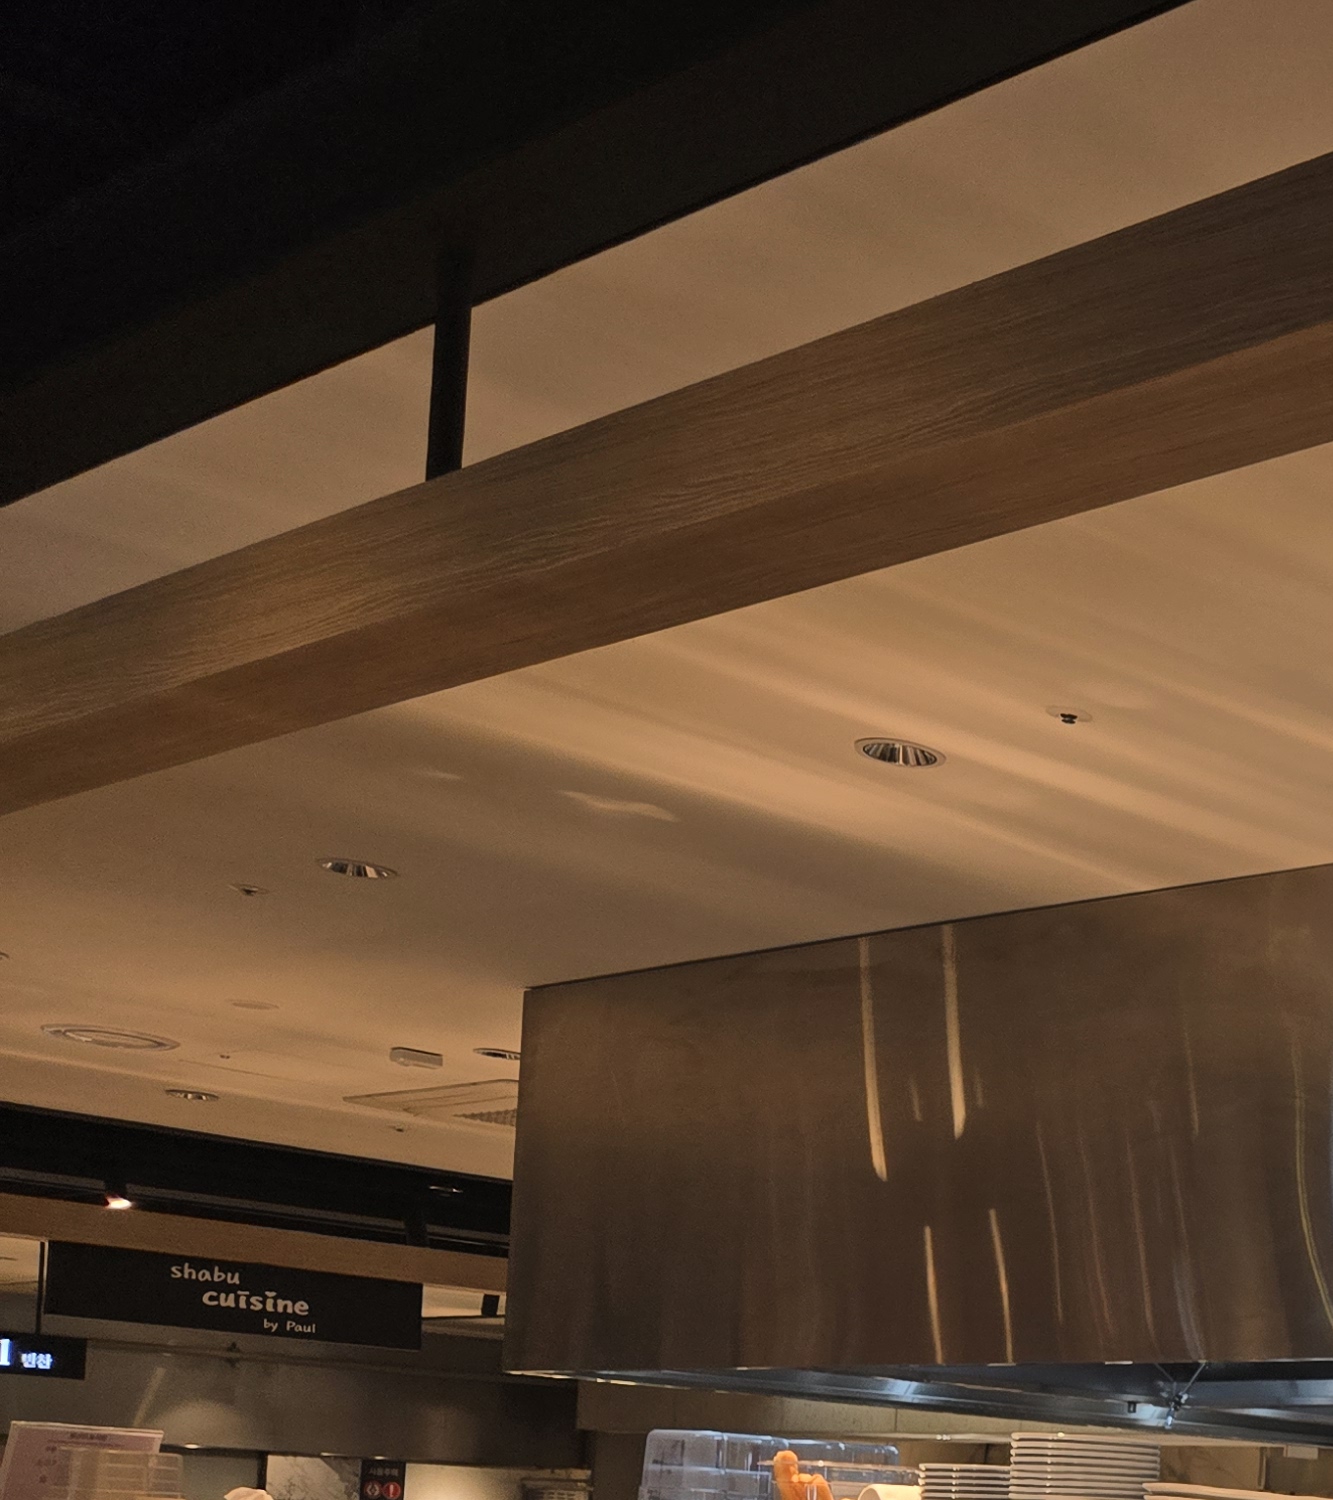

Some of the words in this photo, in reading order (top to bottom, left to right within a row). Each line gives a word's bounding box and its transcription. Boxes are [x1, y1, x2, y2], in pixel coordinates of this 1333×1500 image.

[171, 1263, 240, 1285] shabu
[202, 1290, 309, 1316] cuisine
[264, 1319, 278, 1333] by
[287, 1321, 316, 1334] Paul
